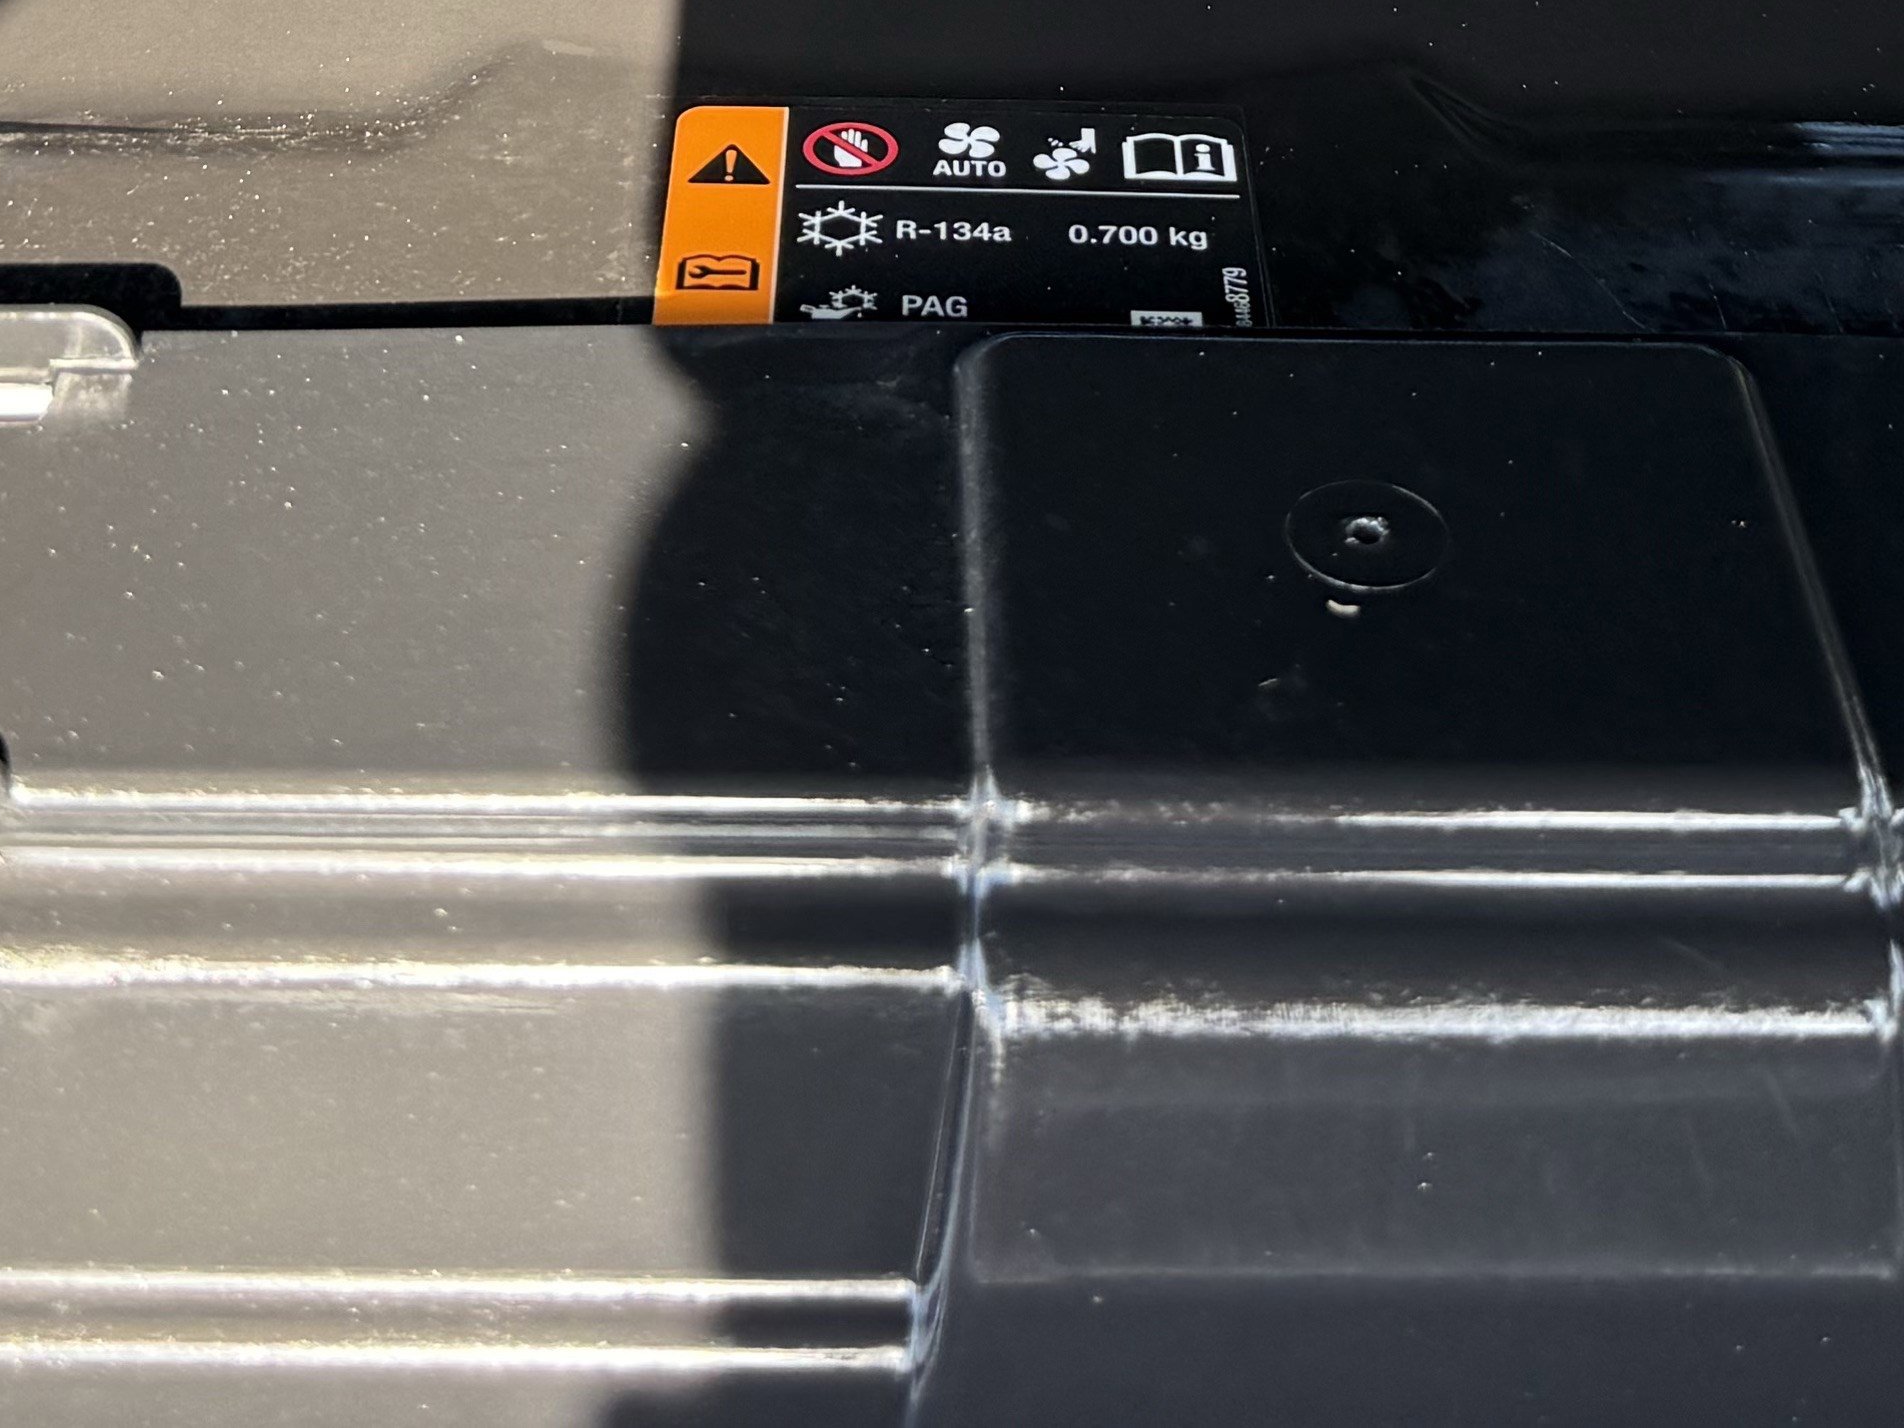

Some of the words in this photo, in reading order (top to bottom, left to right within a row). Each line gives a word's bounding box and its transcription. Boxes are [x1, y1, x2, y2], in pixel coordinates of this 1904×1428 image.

[932, 158, 1007, 178] AUTO
[896, 219, 1012, 243] R-134a
[1068, 224, 1159, 246] 0.700
[1168, 226, 1208, 251] kg
[902, 294, 968, 317] PAG
